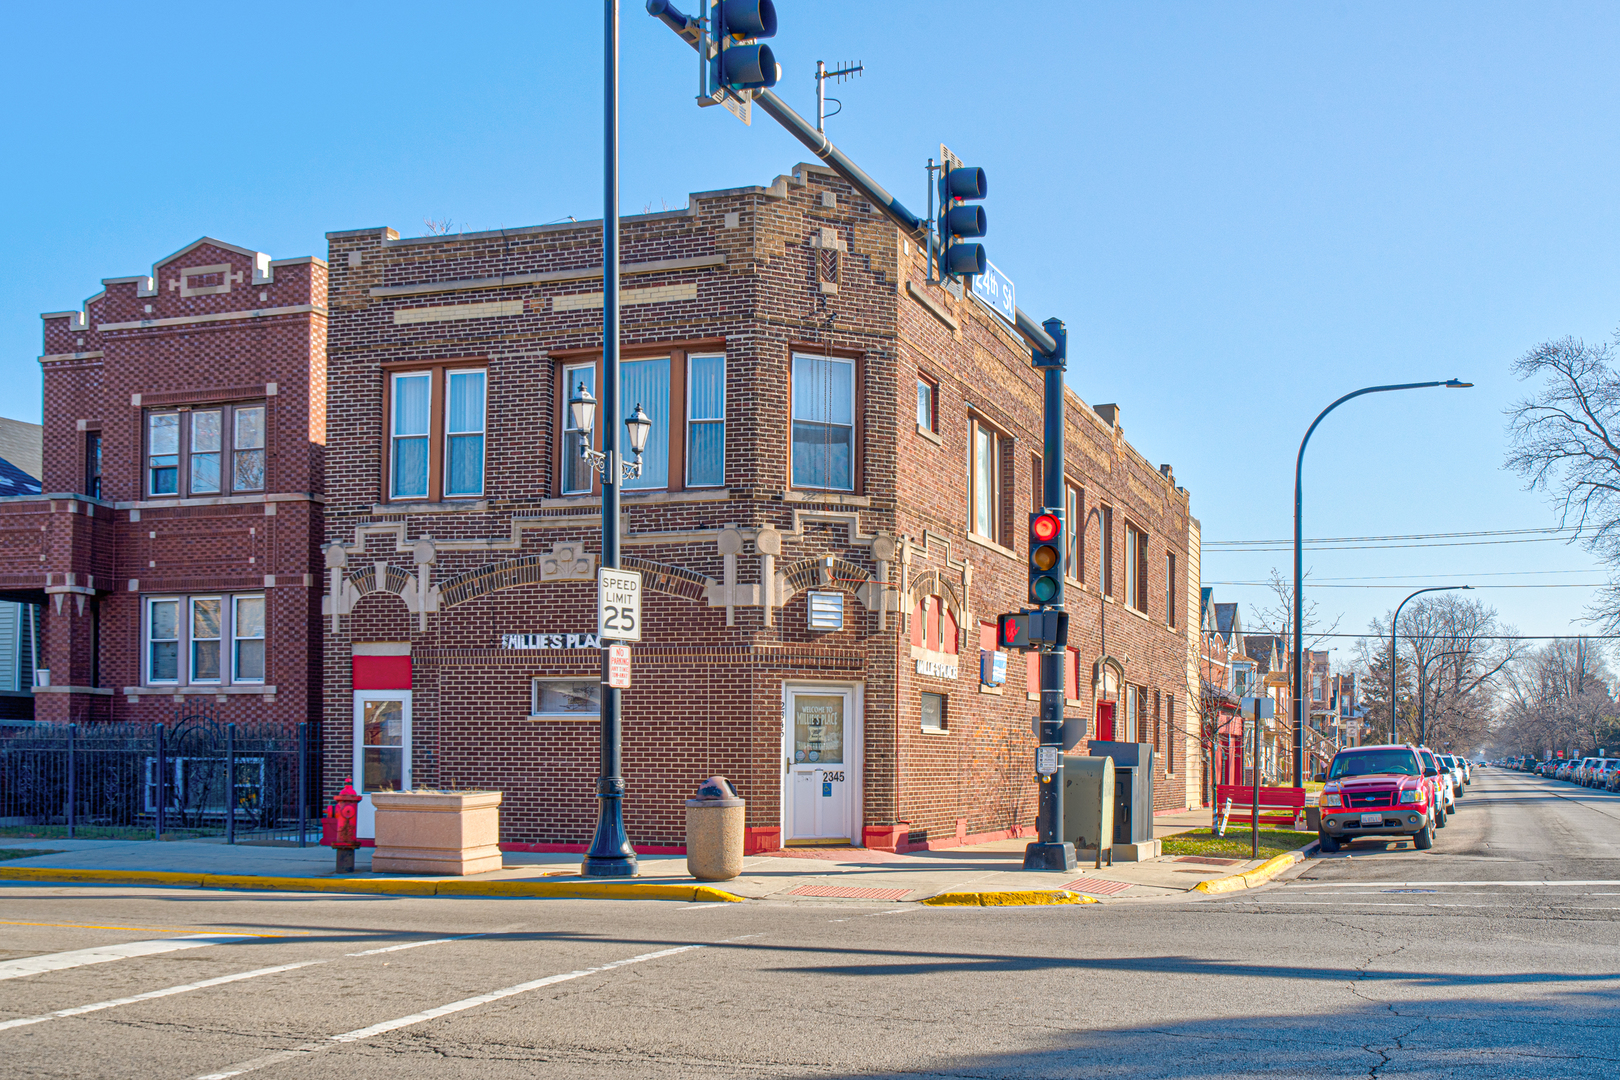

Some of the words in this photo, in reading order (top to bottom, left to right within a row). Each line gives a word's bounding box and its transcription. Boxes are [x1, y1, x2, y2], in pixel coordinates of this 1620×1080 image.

[1003, 284, 1013, 314] St
[602, 578, 637, 591] SPEED
[606, 592, 633, 605] LIMIT
[604, 605, 635, 631] 25
[508, 634, 563, 650] MILLIE'S
[616, 649, 625, 657] NO
[611, 657, 629, 666] PARKING
[796, 711, 820, 725] MILLIE'S
[821, 711, 838, 725] PLACE
[823, 771, 845, 782] 2345
